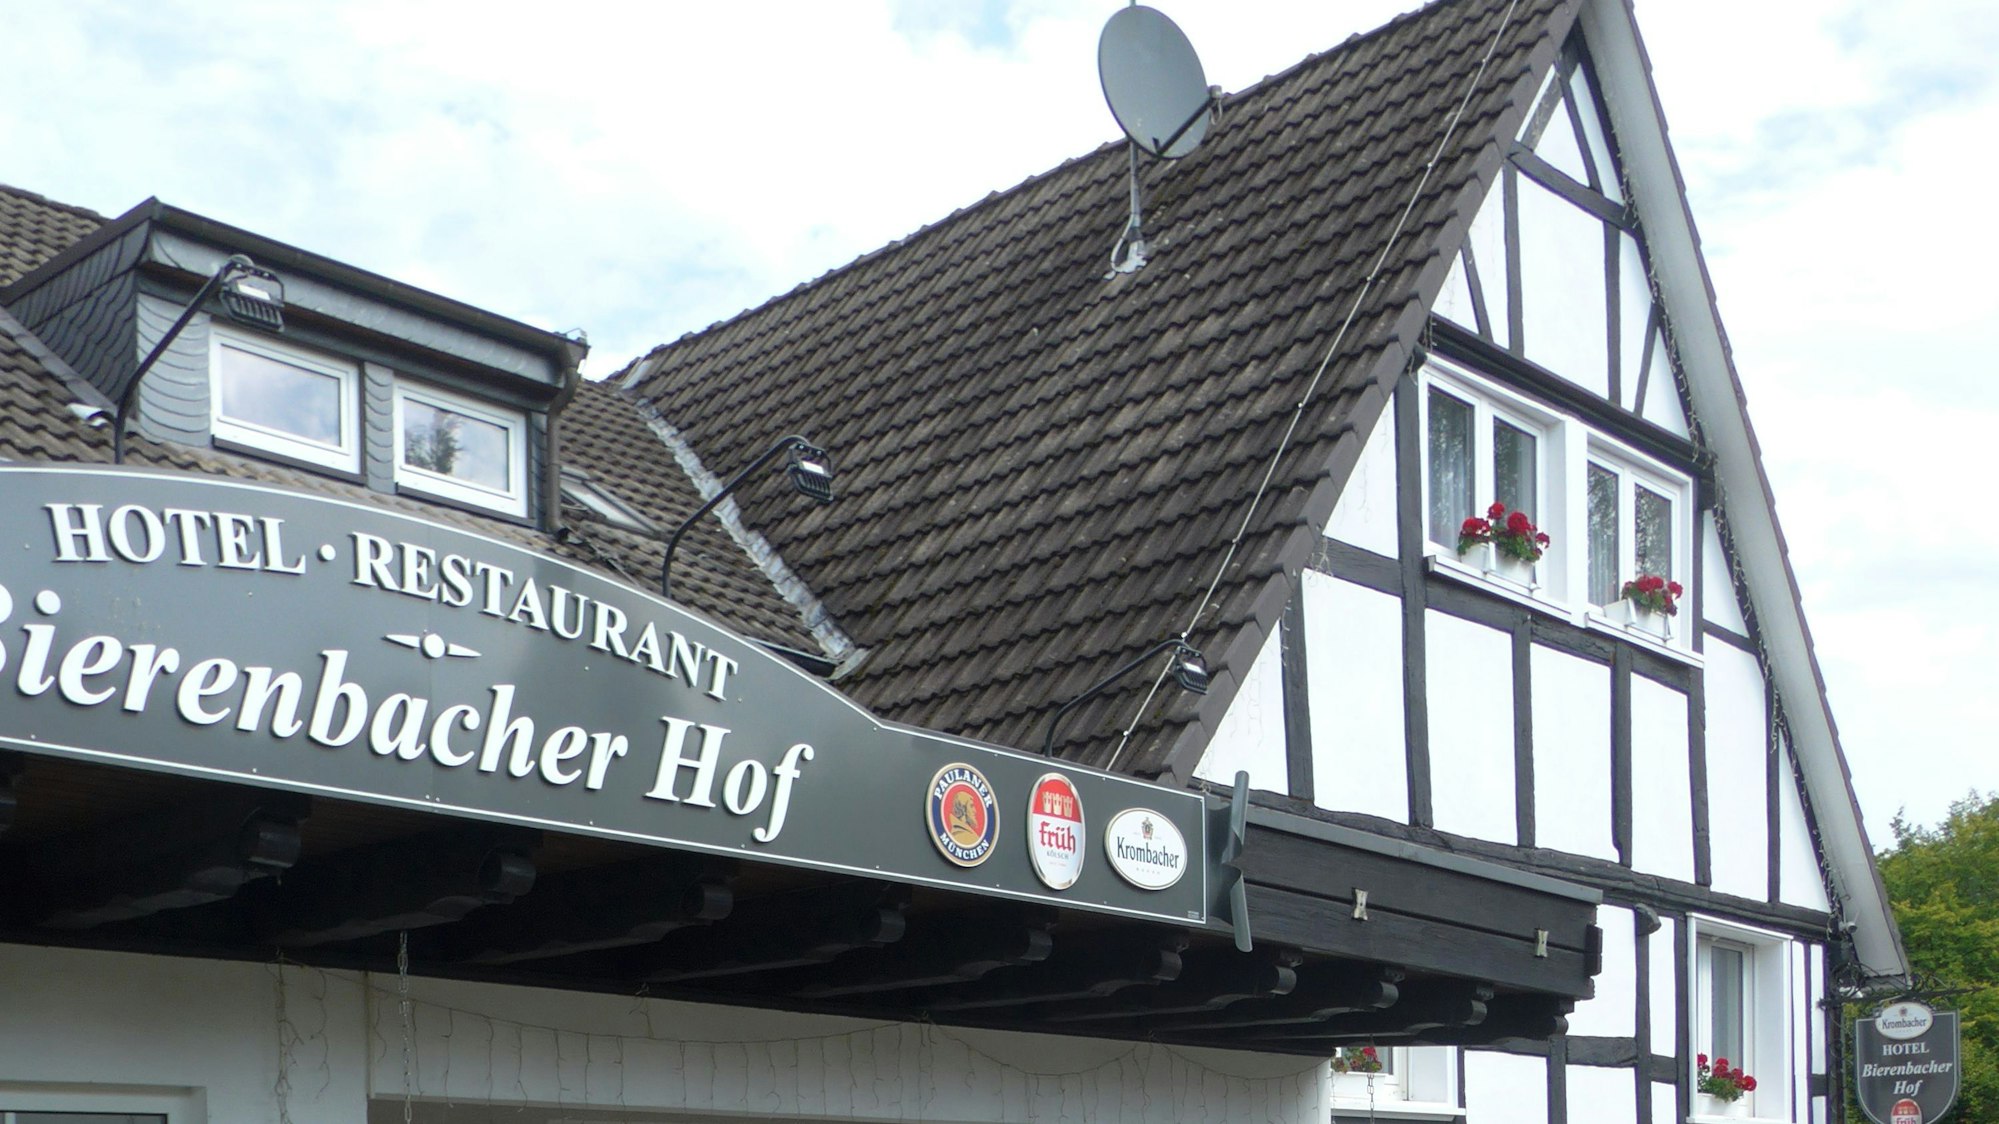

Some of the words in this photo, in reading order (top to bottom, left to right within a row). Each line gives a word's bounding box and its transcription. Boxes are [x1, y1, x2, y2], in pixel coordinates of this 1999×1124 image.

[45, 503, 306, 574] HOTEL
[351, 531, 738, 701] RESTAURANT
[0, 583, 628, 790] ierenbacher
[644, 716, 815, 843] Hof
[934, 769, 993, 808] PAULANER
[1039, 821, 1076, 855] früh
[1117, 836, 1179, 869] Krombacher
[1882, 1017, 1927, 1029] Krombacher
[1882, 1042, 1930, 1055] HOTEL
[1861, 1060, 1953, 1077] Bierenbacher
[1893, 1080, 1923, 1096] Hof
